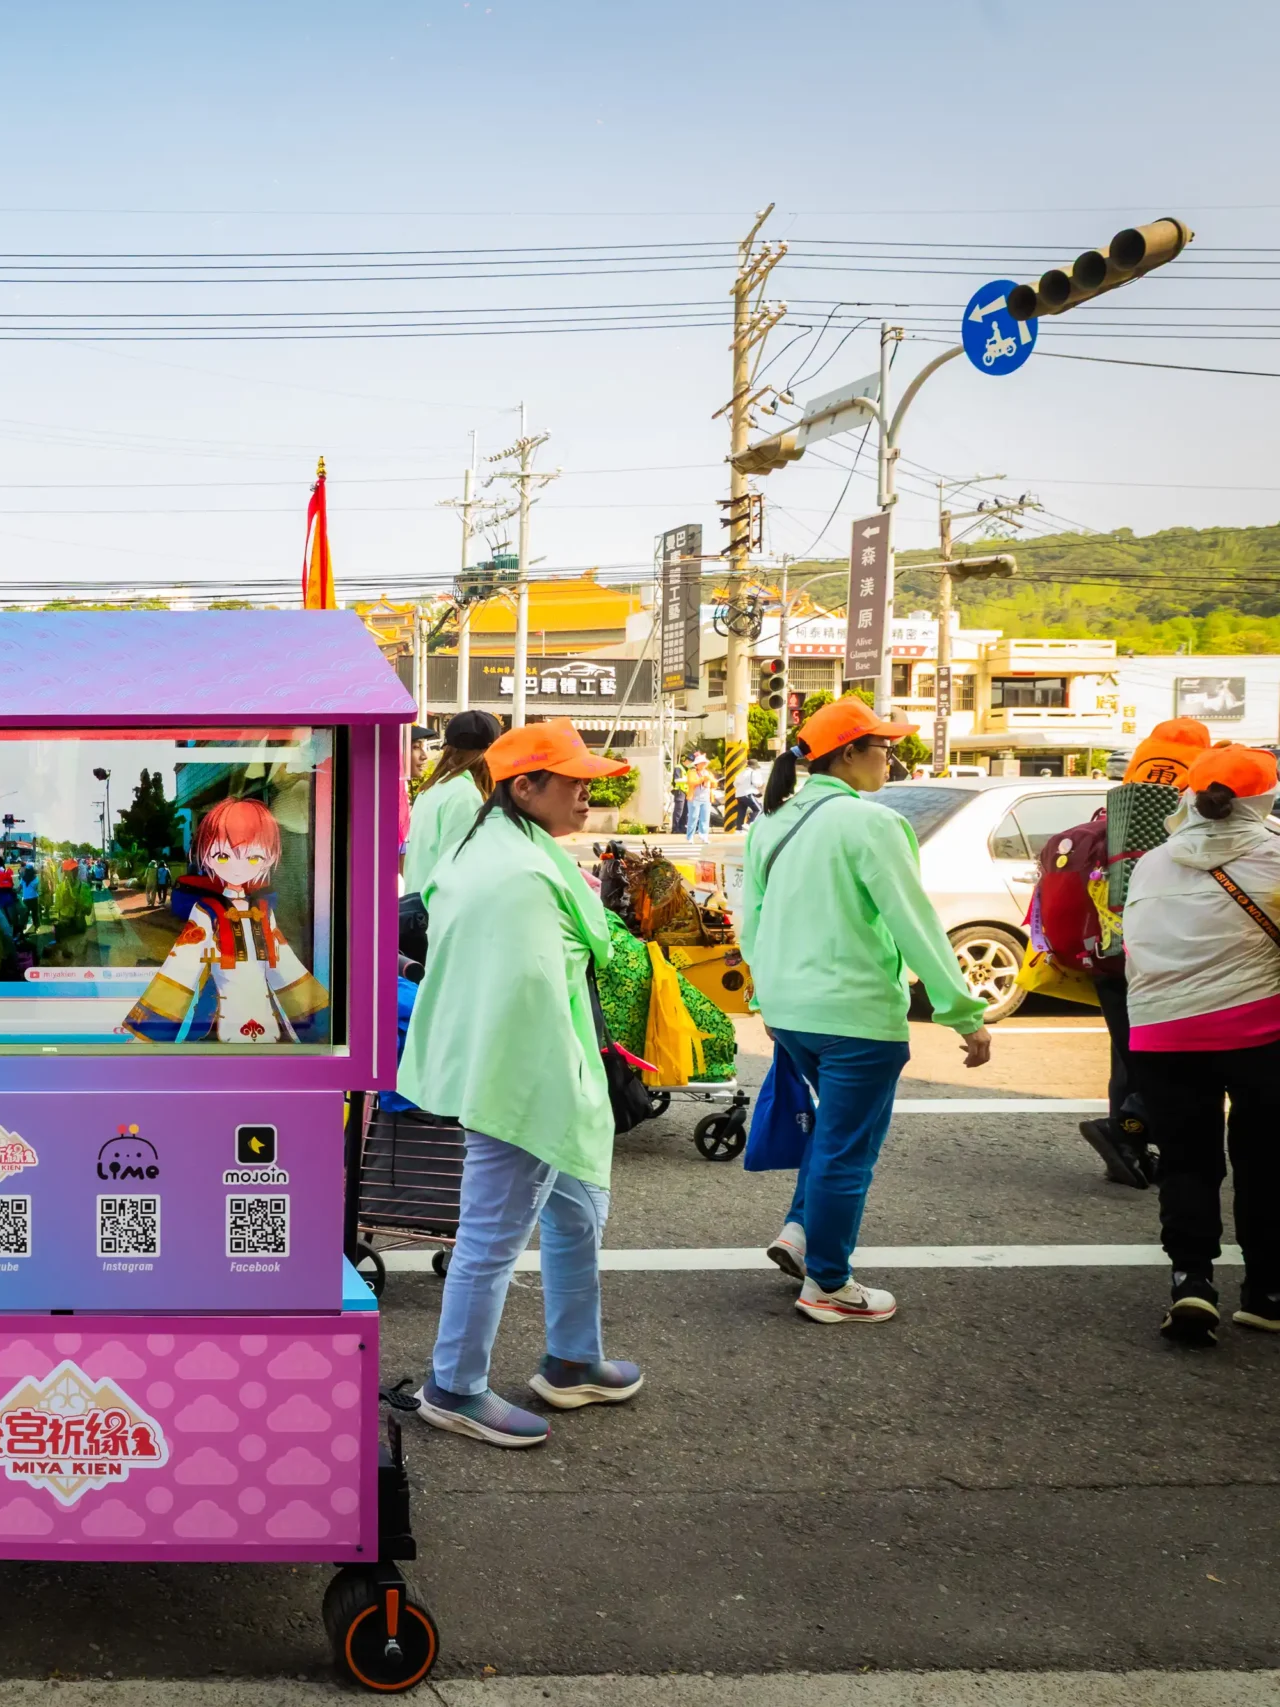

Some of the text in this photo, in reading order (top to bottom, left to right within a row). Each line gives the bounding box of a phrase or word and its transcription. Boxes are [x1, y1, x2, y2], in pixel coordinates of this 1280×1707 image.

[855, 637, 873, 647] Alive
[849, 648, 879, 660] Glamping
[855, 661, 871, 671] Base
[102, 1261, 154, 1273] Instagram
[230, 1261, 281, 1273] Facebook
[5, 1411, 130, 1456] 宮祈緣
[12, 1461, 122, 1476] MIYA KIEN
